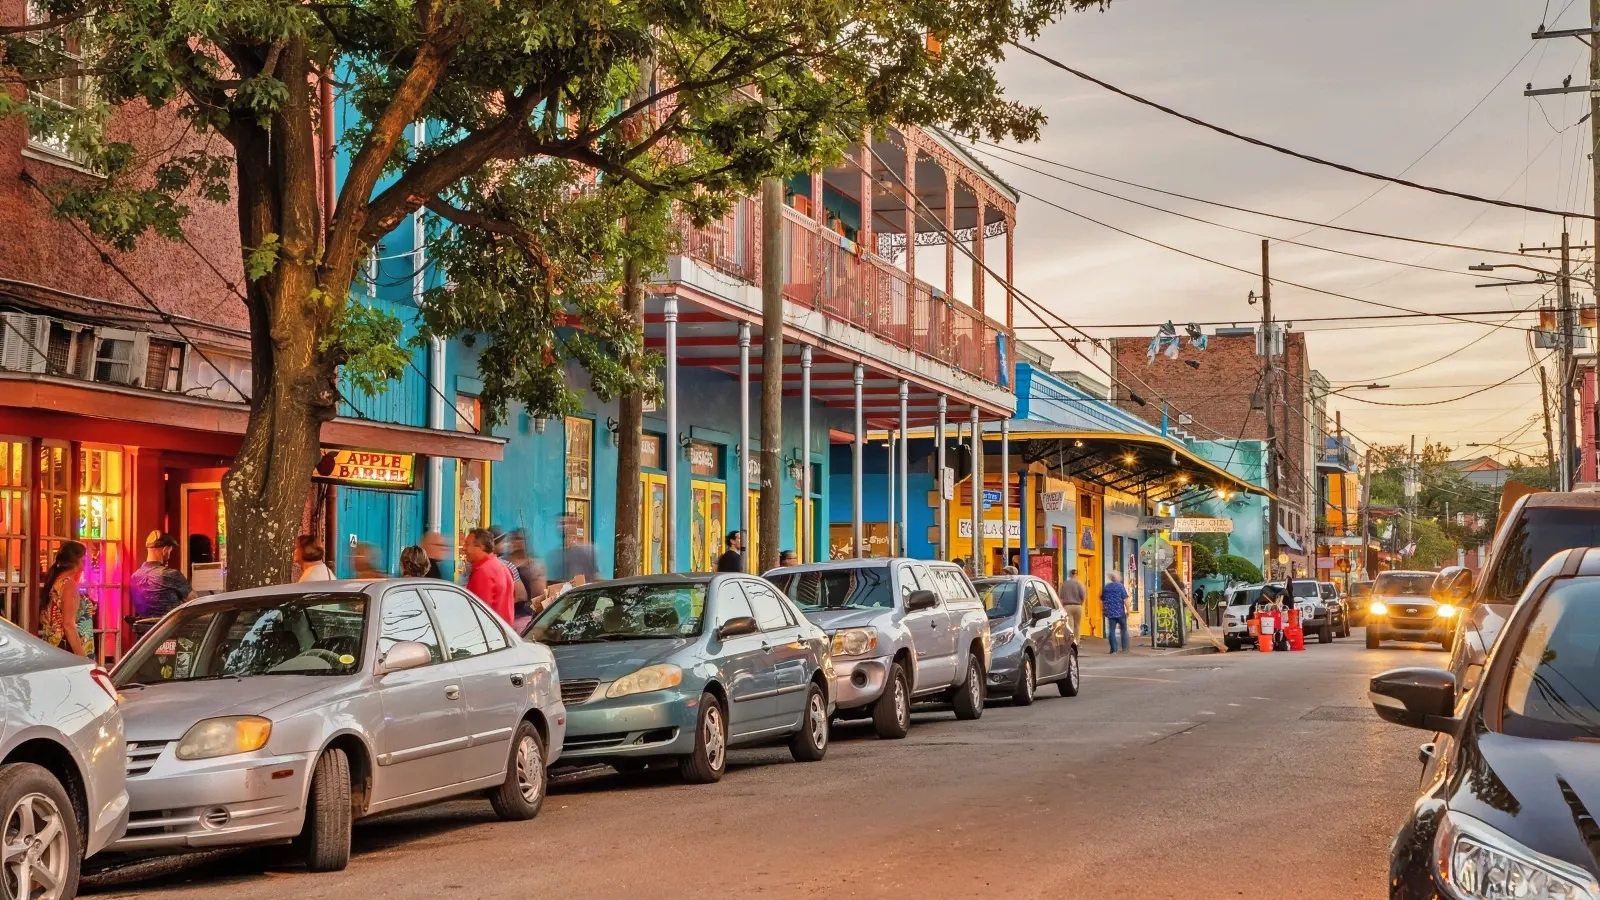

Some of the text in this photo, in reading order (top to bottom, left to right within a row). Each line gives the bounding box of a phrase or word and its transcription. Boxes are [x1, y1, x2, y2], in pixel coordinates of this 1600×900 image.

[347, 453, 401, 468] APPLE
[340, 466, 406, 481] BARREL
[961, 522, 997, 534] FALA
[1209, 519, 1228, 527] CHIC
